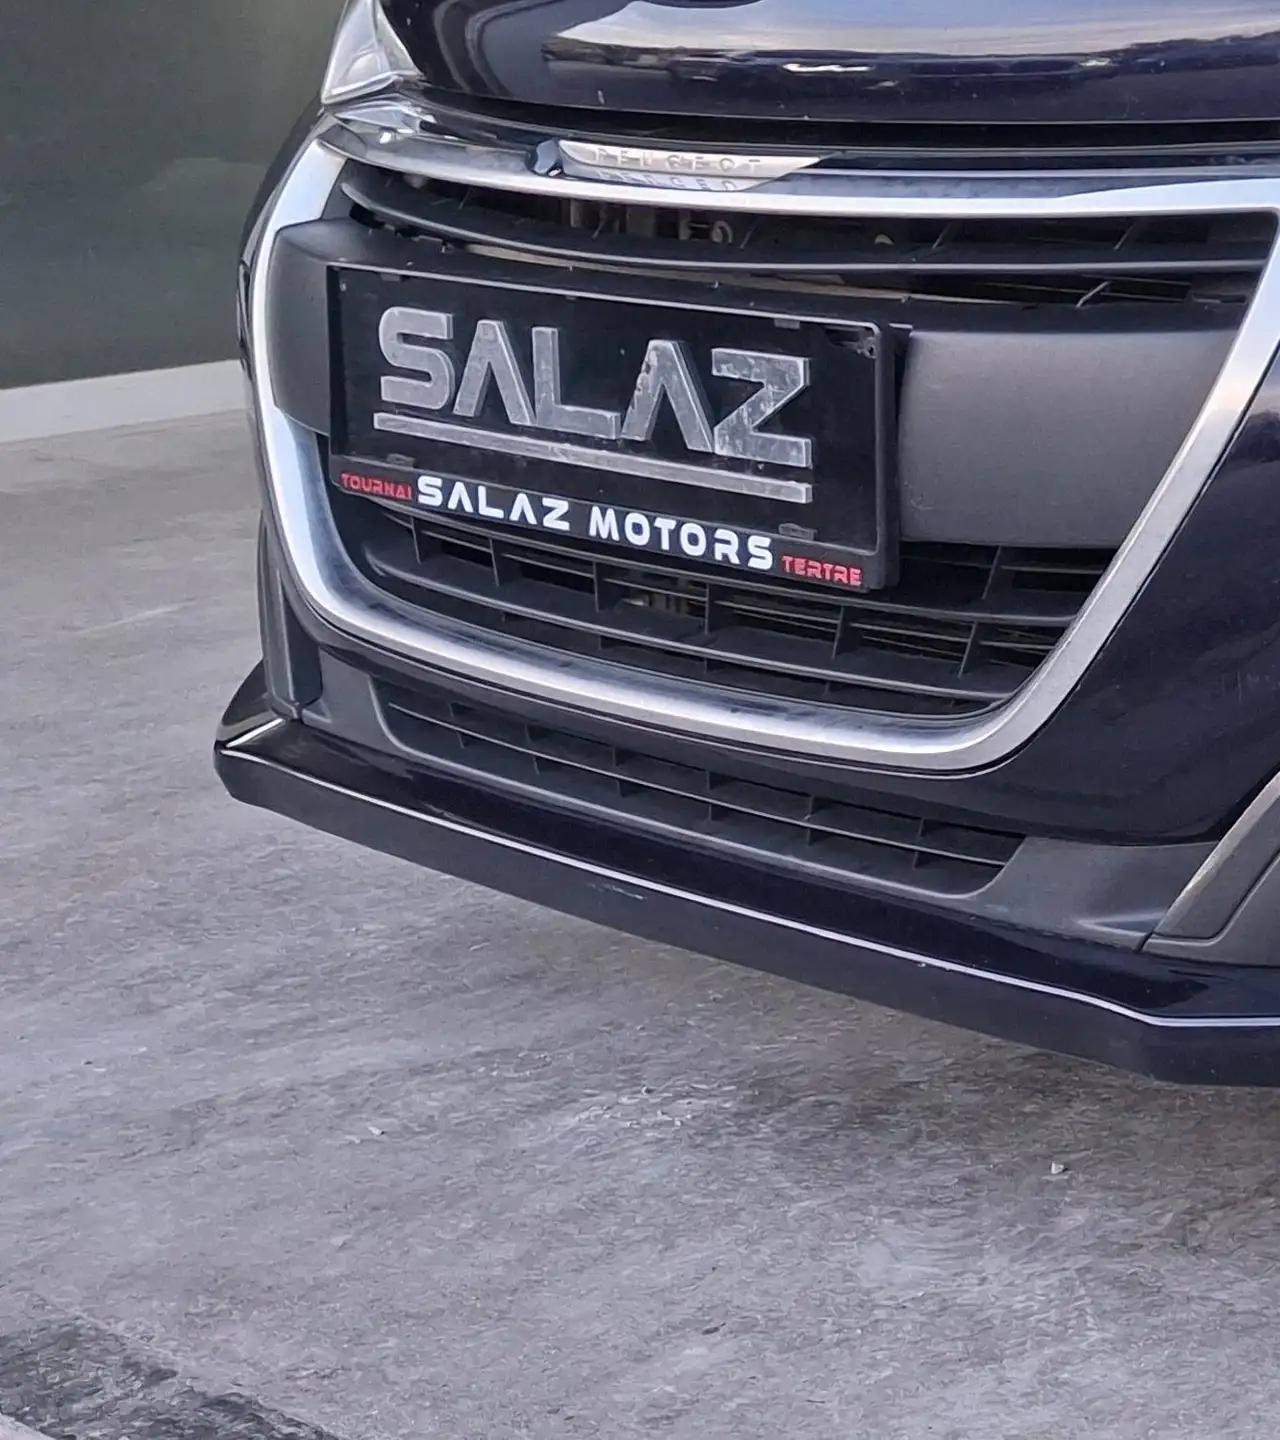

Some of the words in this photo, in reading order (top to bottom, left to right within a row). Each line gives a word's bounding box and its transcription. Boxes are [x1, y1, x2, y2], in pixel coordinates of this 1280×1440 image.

[594, 147, 761, 173] PEUGEOT
[379, 306, 812, 469] SALAZ
[340, 472, 414, 501] TOURNAI
[417, 475, 571, 532] SALAZ
[588, 505, 773, 571] MOTORS
[781, 555, 863, 587] TERTRE
